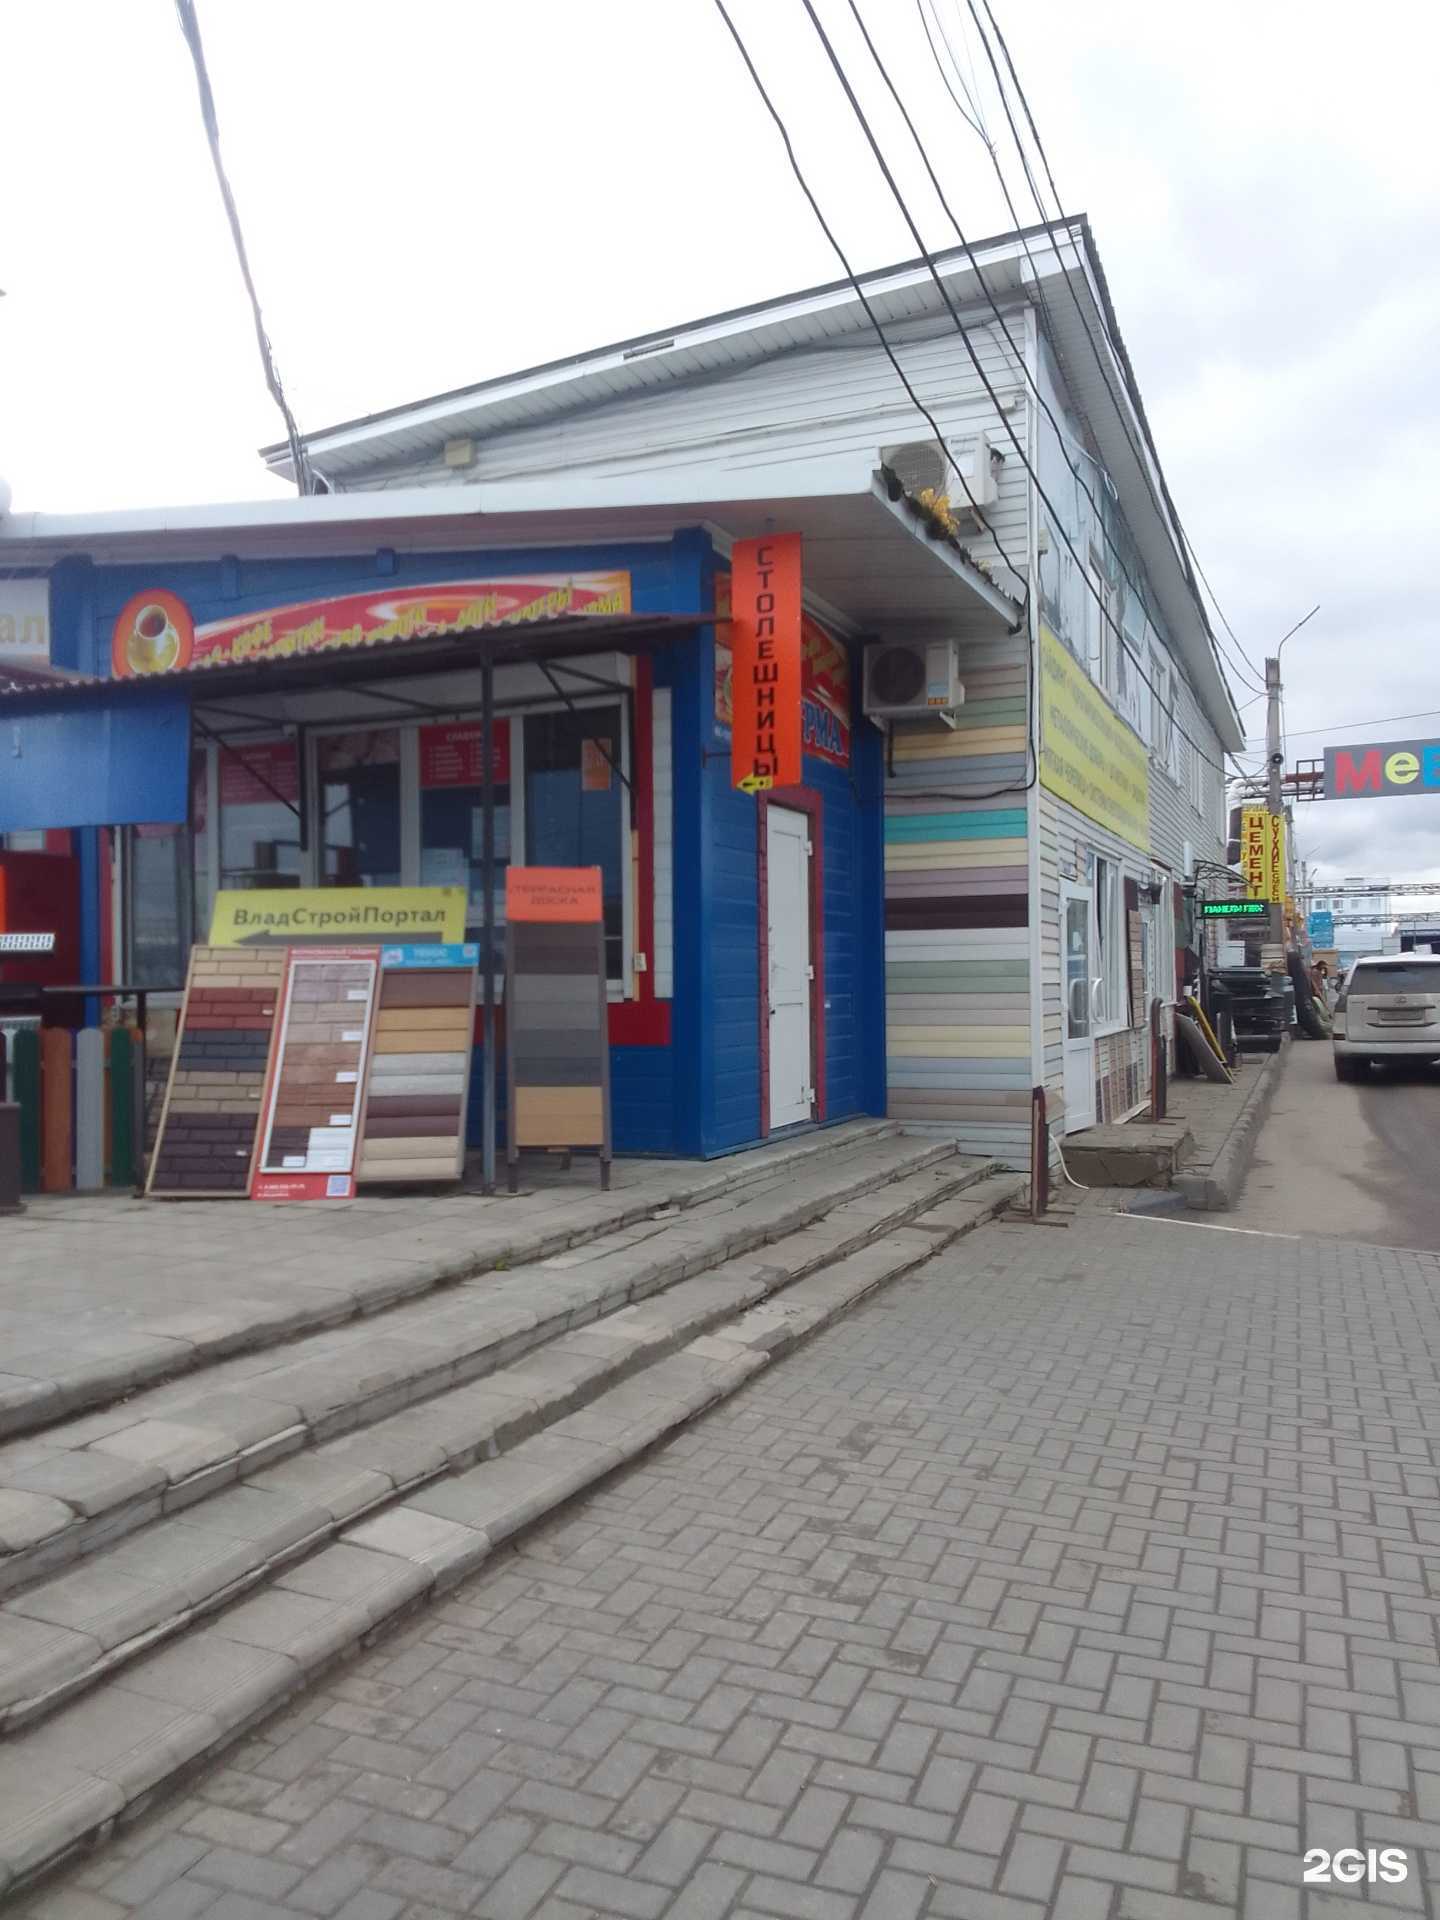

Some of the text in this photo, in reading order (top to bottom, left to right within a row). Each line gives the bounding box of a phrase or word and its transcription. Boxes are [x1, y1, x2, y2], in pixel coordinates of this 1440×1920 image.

[753, 545, 778, 777] СТОЛЕШНИЦЫ
[801, 697, 843, 757] РМА
[1249, 817, 1264, 897] ЦЕМЕНТ
[233, 907, 447, 927] ВладСтройПортал
